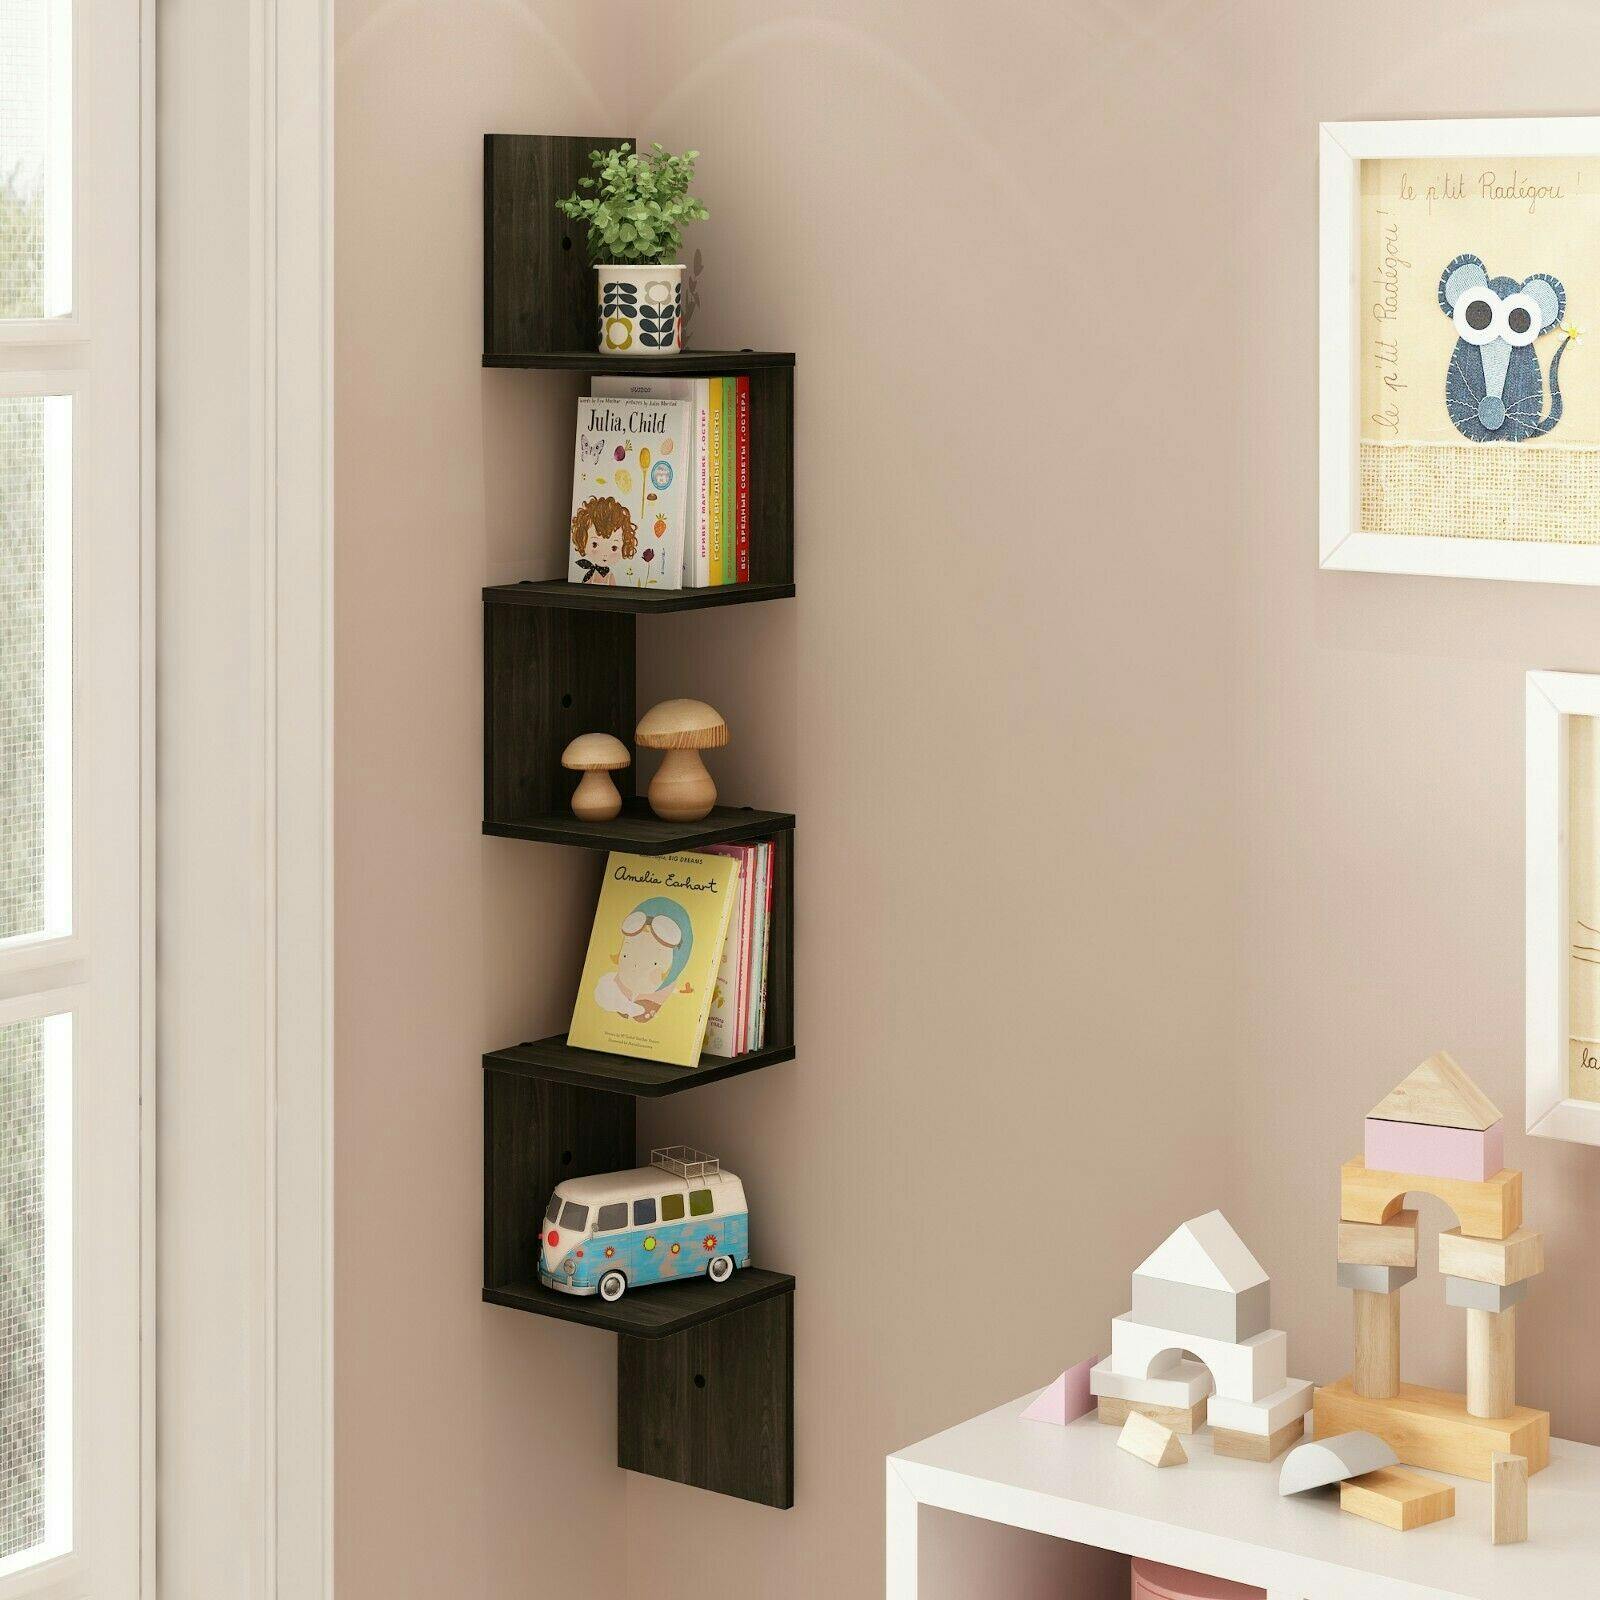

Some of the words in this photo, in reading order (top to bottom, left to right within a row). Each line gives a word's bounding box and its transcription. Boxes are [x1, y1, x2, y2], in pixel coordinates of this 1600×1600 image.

[1400, 171, 1417, 200] le
[1478, 170, 1566, 214] Radégou
[1373, 223, 1411, 323] Radégou
[587, 409, 626, 434] Julia,
[629, 411, 667, 434] Child
[1372, 402, 1399, 434] le
[614, 866, 662, 885] Amelia
[665, 872, 718, 893] Earhart
